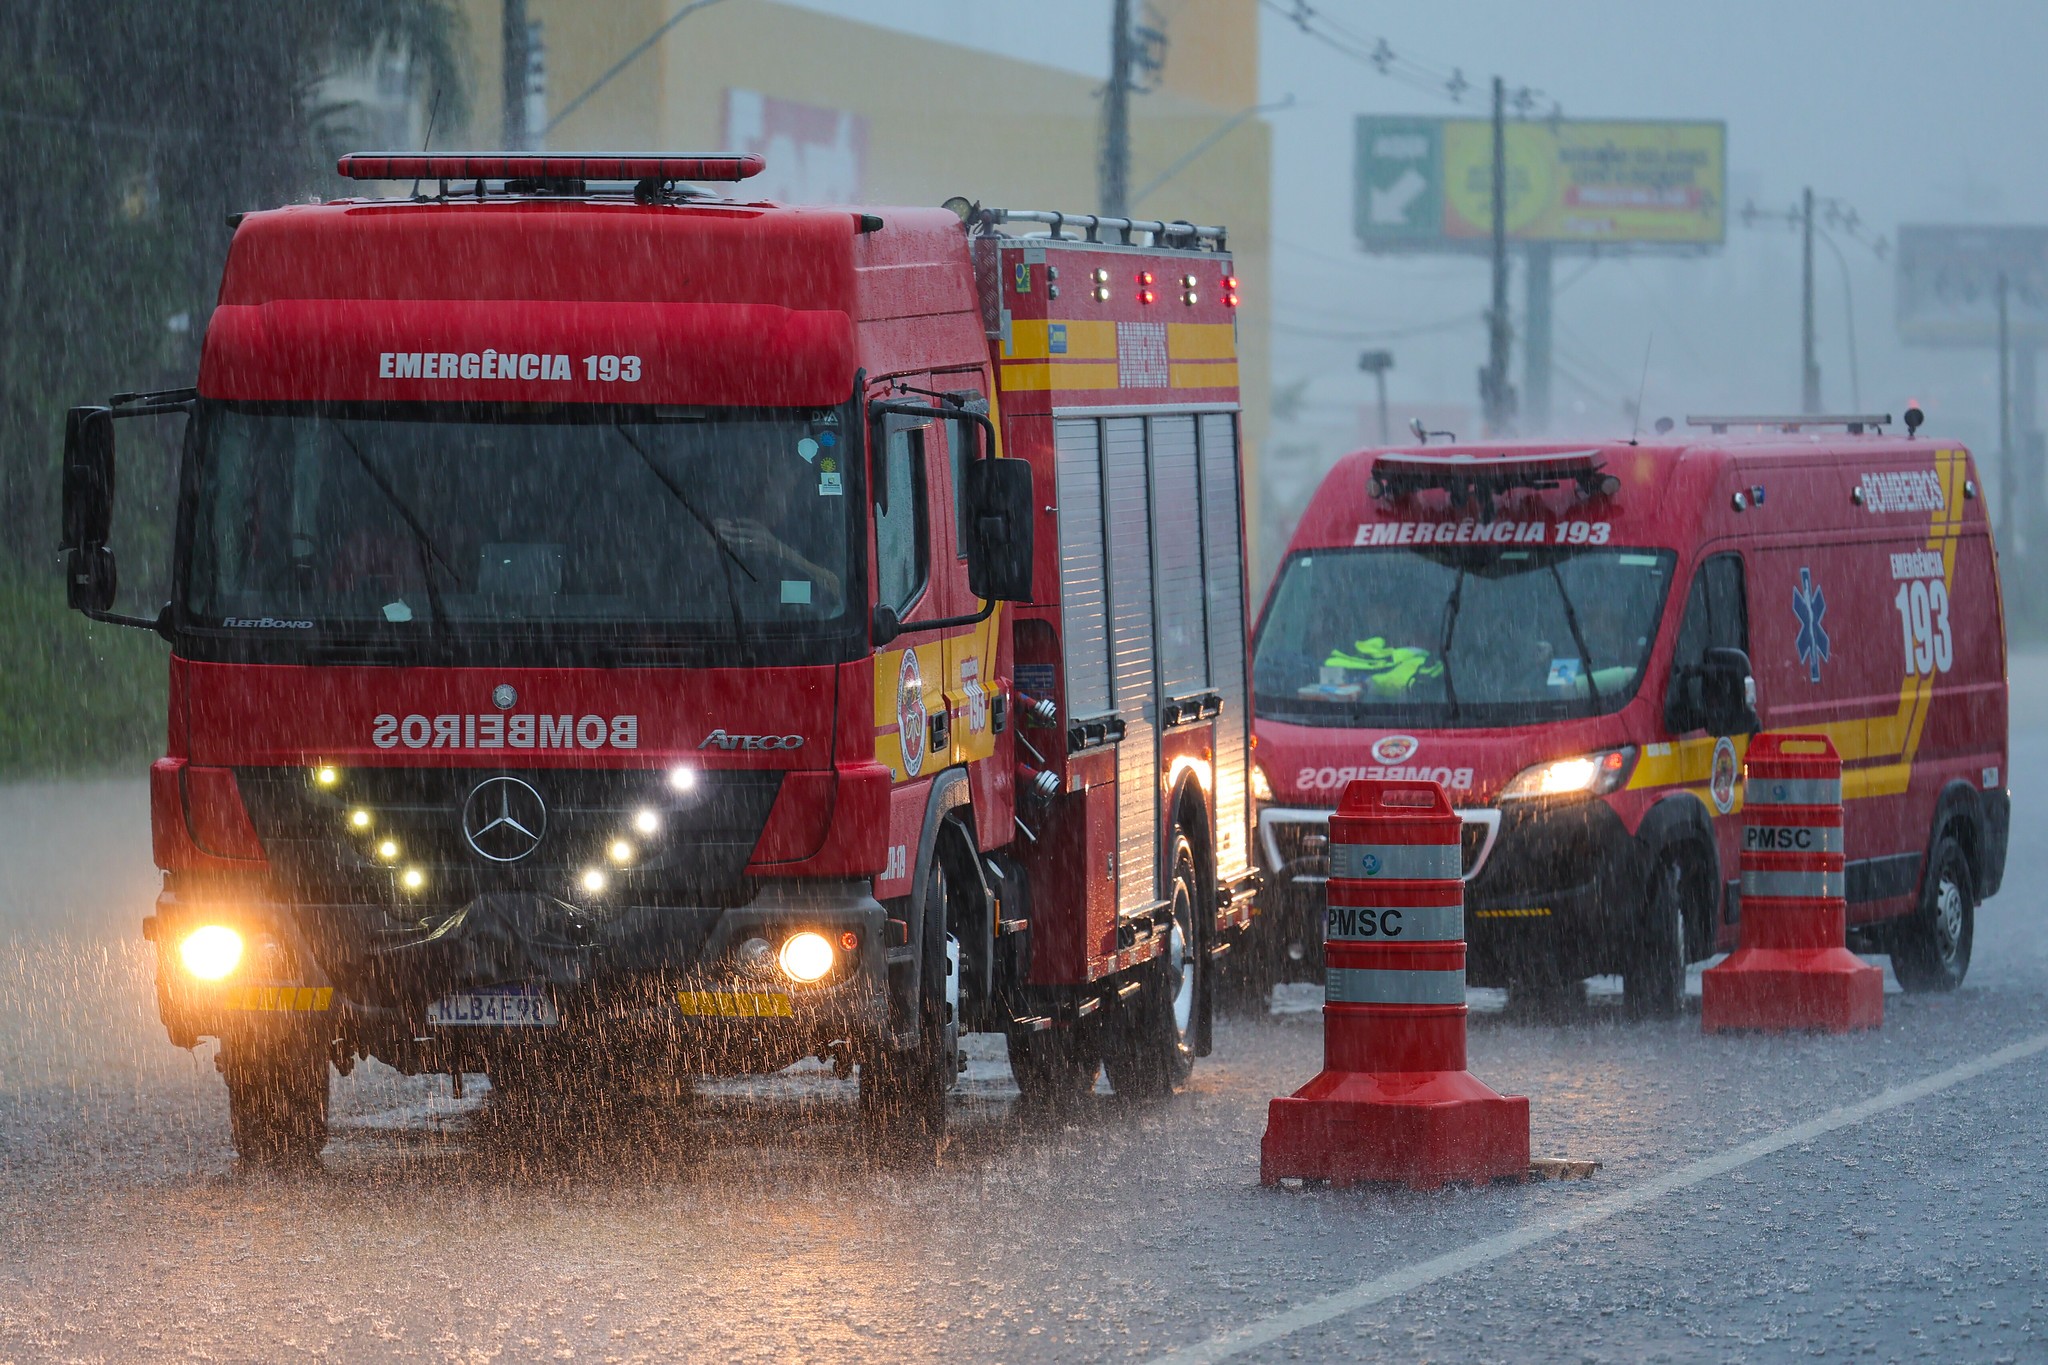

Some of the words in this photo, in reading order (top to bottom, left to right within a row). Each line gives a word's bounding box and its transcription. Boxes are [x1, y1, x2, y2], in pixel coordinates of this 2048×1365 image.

[379, 349, 572, 381] EMERGÊNCIA
[583, 355, 642, 382] 193
[1861, 469, 1945, 513] BOMBEIROS
[1354, 517, 1546, 546] EMERGÊNCIA
[1554, 521, 1612, 545] 193
[1890, 548, 1945, 580] EMERGÊNCIA
[1895, 579, 1953, 675] 193
[1747, 828, 1812, 849] PMSC
[1328, 909, 1403, 937] PMSC
